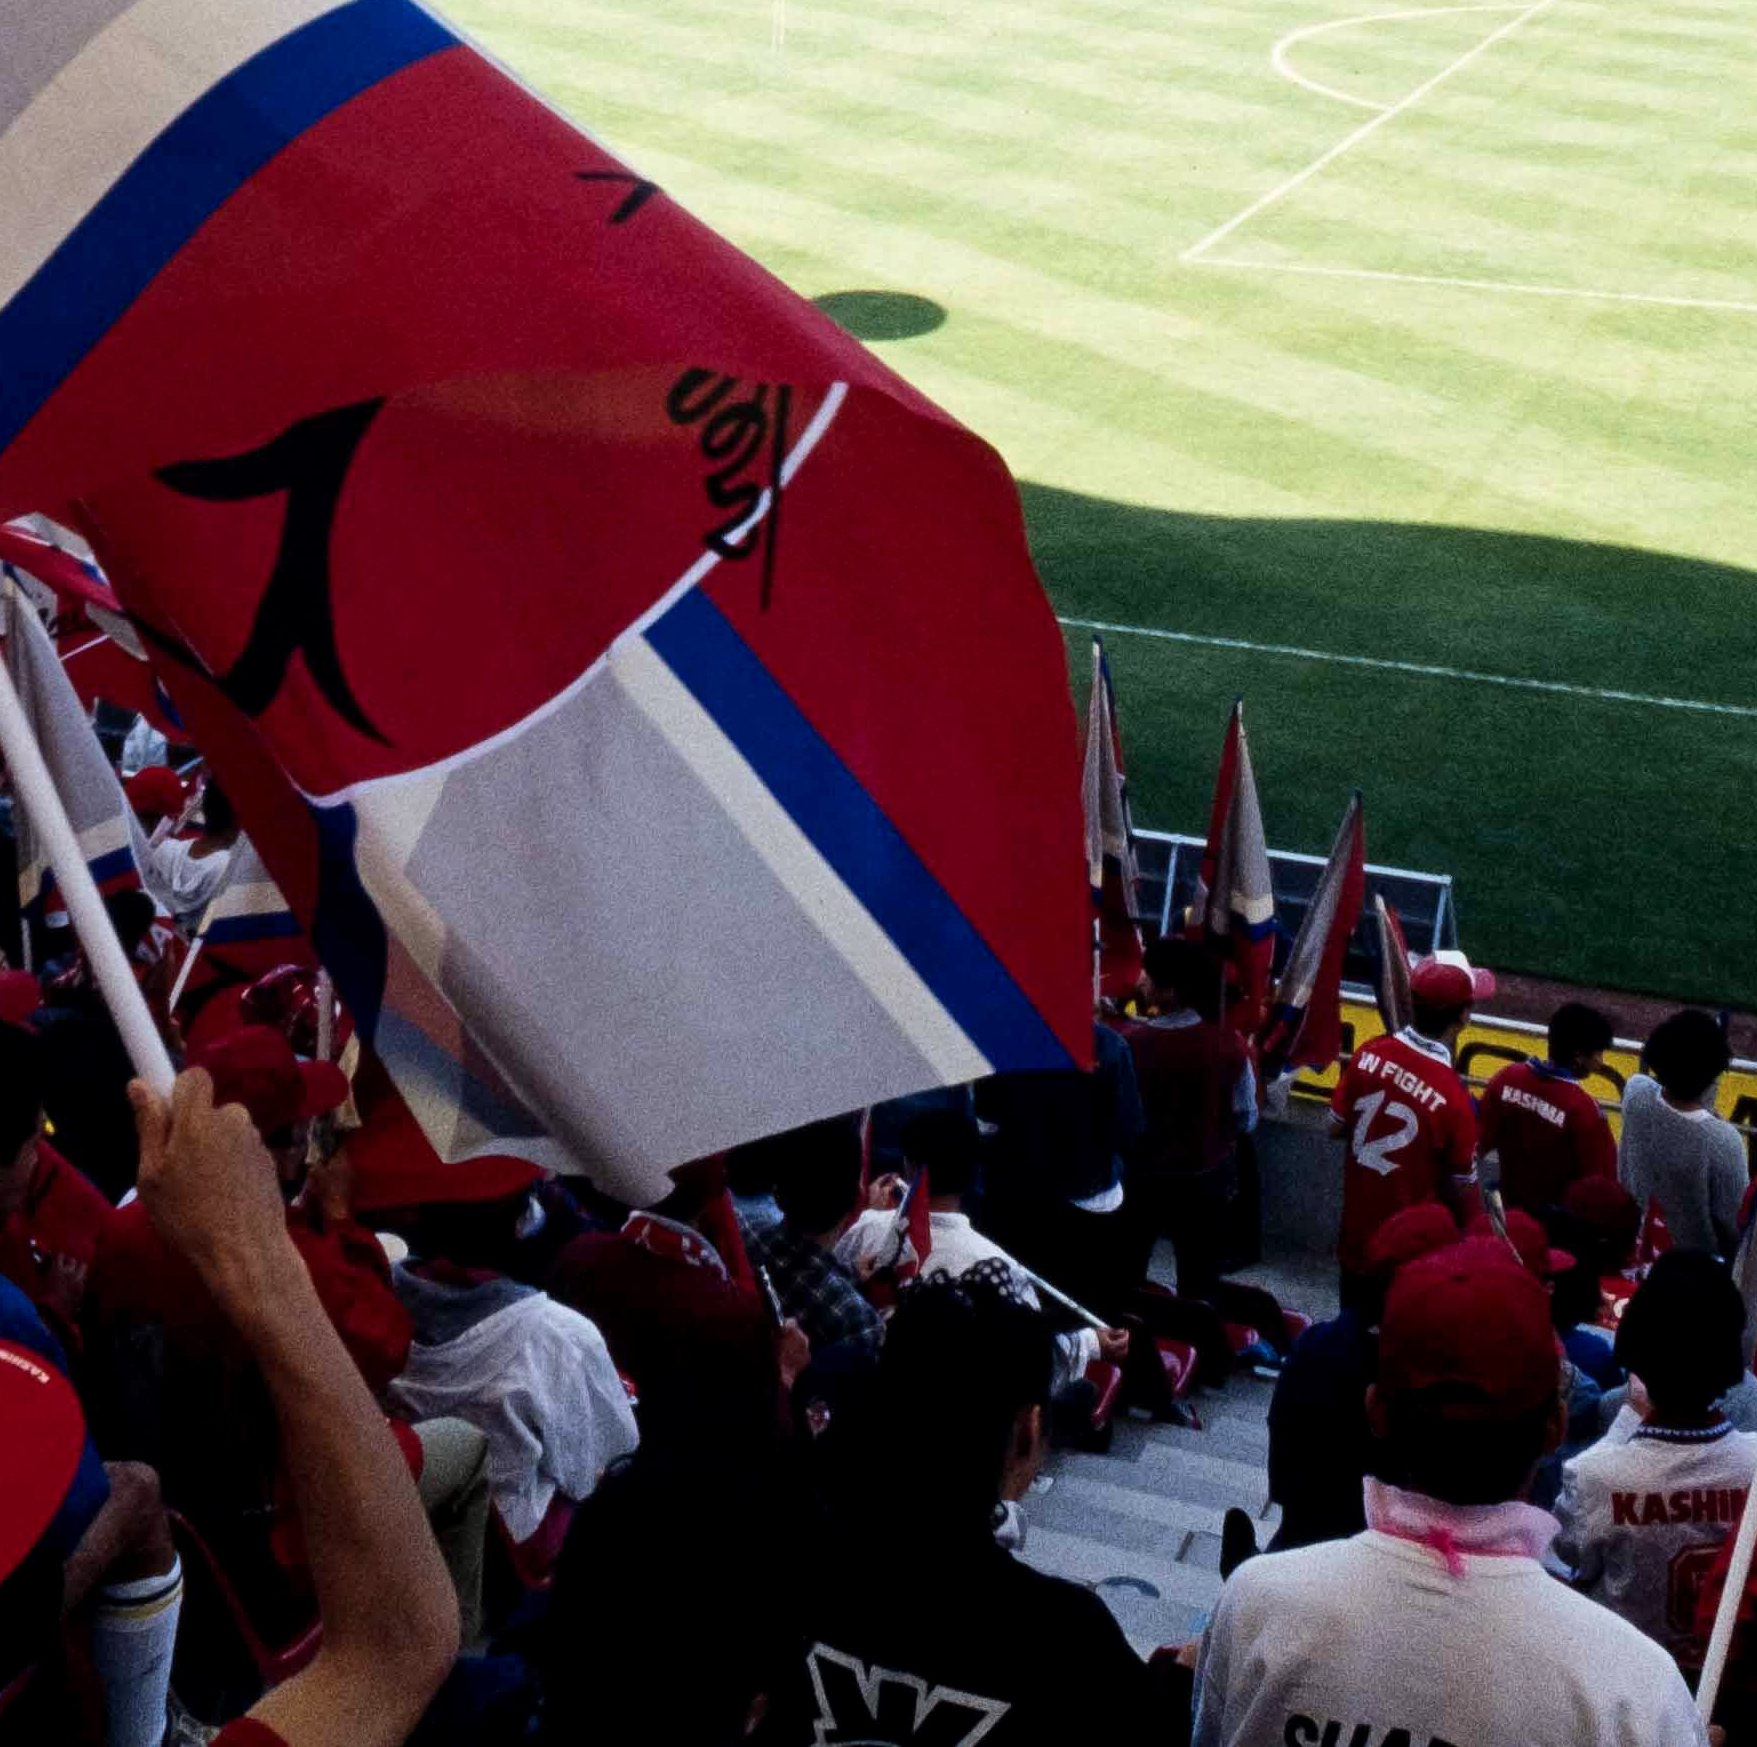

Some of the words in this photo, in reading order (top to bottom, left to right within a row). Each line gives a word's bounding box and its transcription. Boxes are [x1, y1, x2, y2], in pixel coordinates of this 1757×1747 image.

[1380, 1060, 1447, 1112] FIGHT
[1501, 1085, 1566, 1129] KASHIMA
[1351, 1089, 1419, 1176] 12
[1611, 1488, 1750, 1526] KASHI
